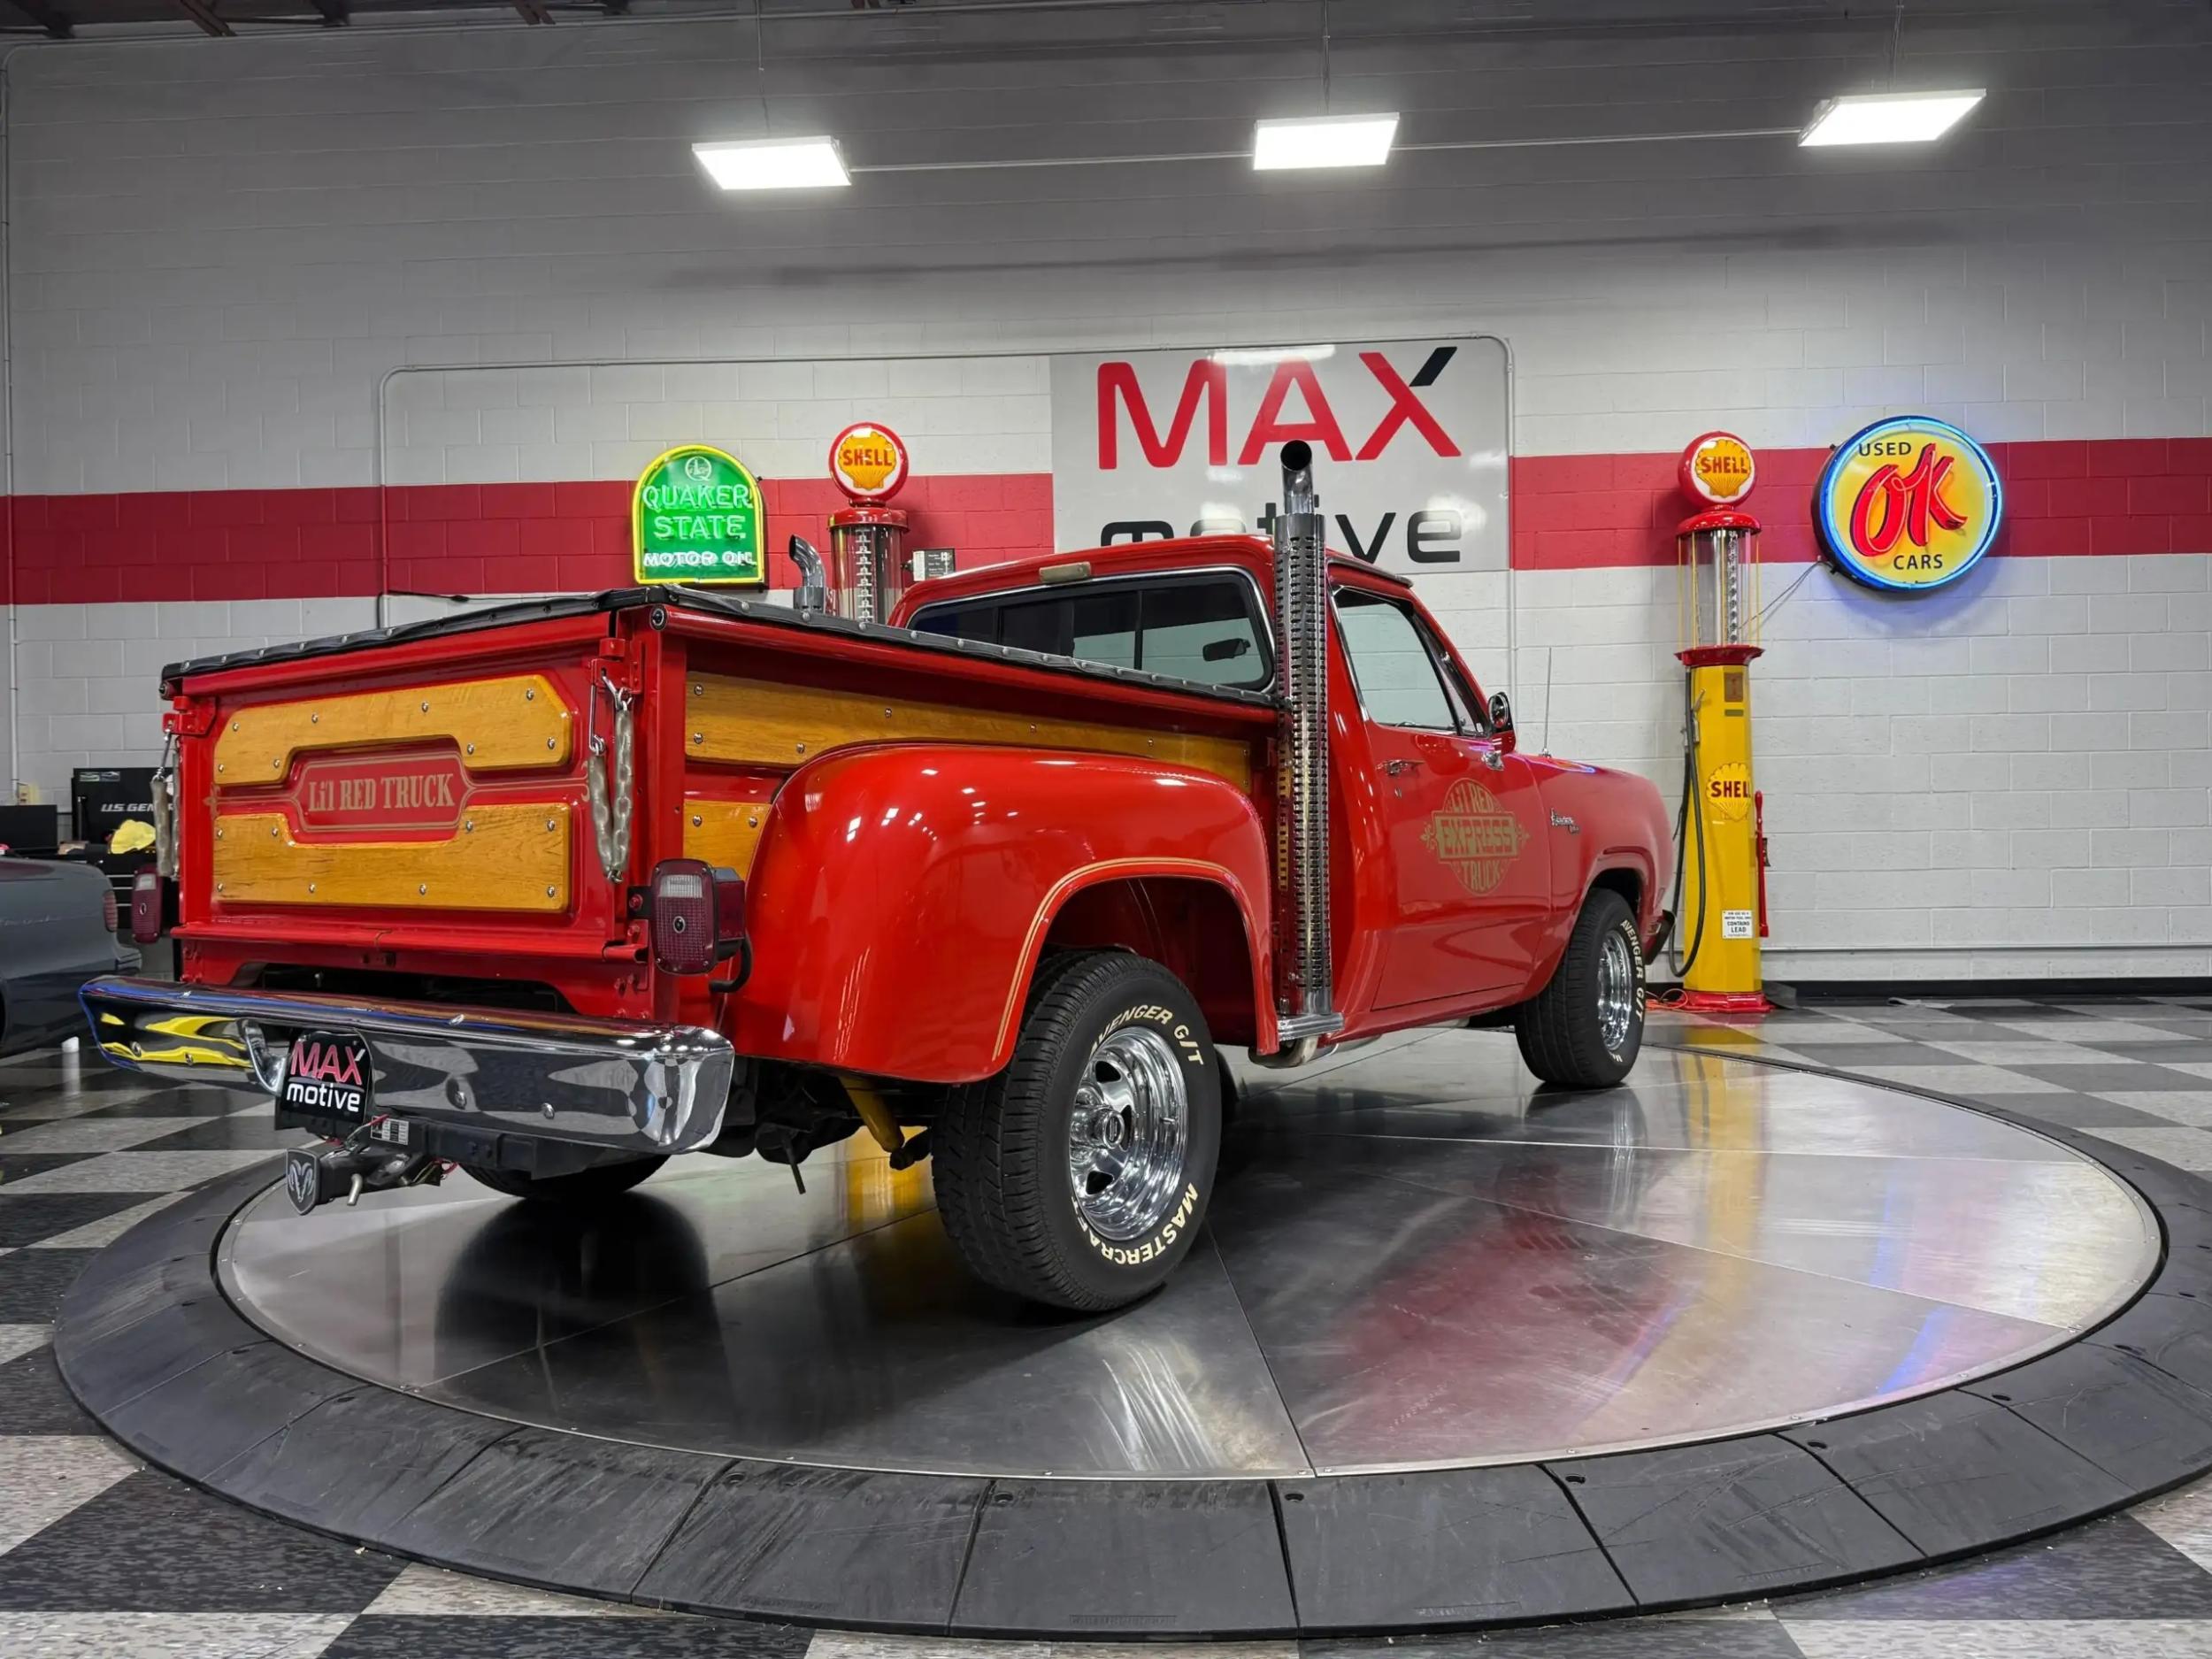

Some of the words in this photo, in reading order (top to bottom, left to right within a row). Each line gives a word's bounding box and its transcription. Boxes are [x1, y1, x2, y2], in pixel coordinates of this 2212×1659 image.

[1097, 346, 1462, 469] MAX
[842, 449, 893, 466] SHELL
[1858, 442, 1912, 457] USED
[1701, 457, 1748, 474] SHELL
[641, 484, 754, 513] QUAKER
[1849, 442, 1968, 557] OK
[654, 514, 747, 541] STATE
[1100, 495, 1463, 565] mve
[643, 551, 718, 567] MOTOR
[721, 551, 757, 567] OIL
[1893, 554, 1943, 570] CARS
[339, 778, 377, 810] RED
[380, 773, 456, 809] TRUCK
[1710, 780, 1751, 798] SHEL
[1460, 860, 1502, 892] TRUCK
[1620, 919, 1644, 979] AVENGER
[1636, 987, 1645, 1023] G/T
[1173, 1025, 1204, 1065] G/T
[290, 1041, 365, 1087] MAX
[286, 1083, 361, 1113] motive
